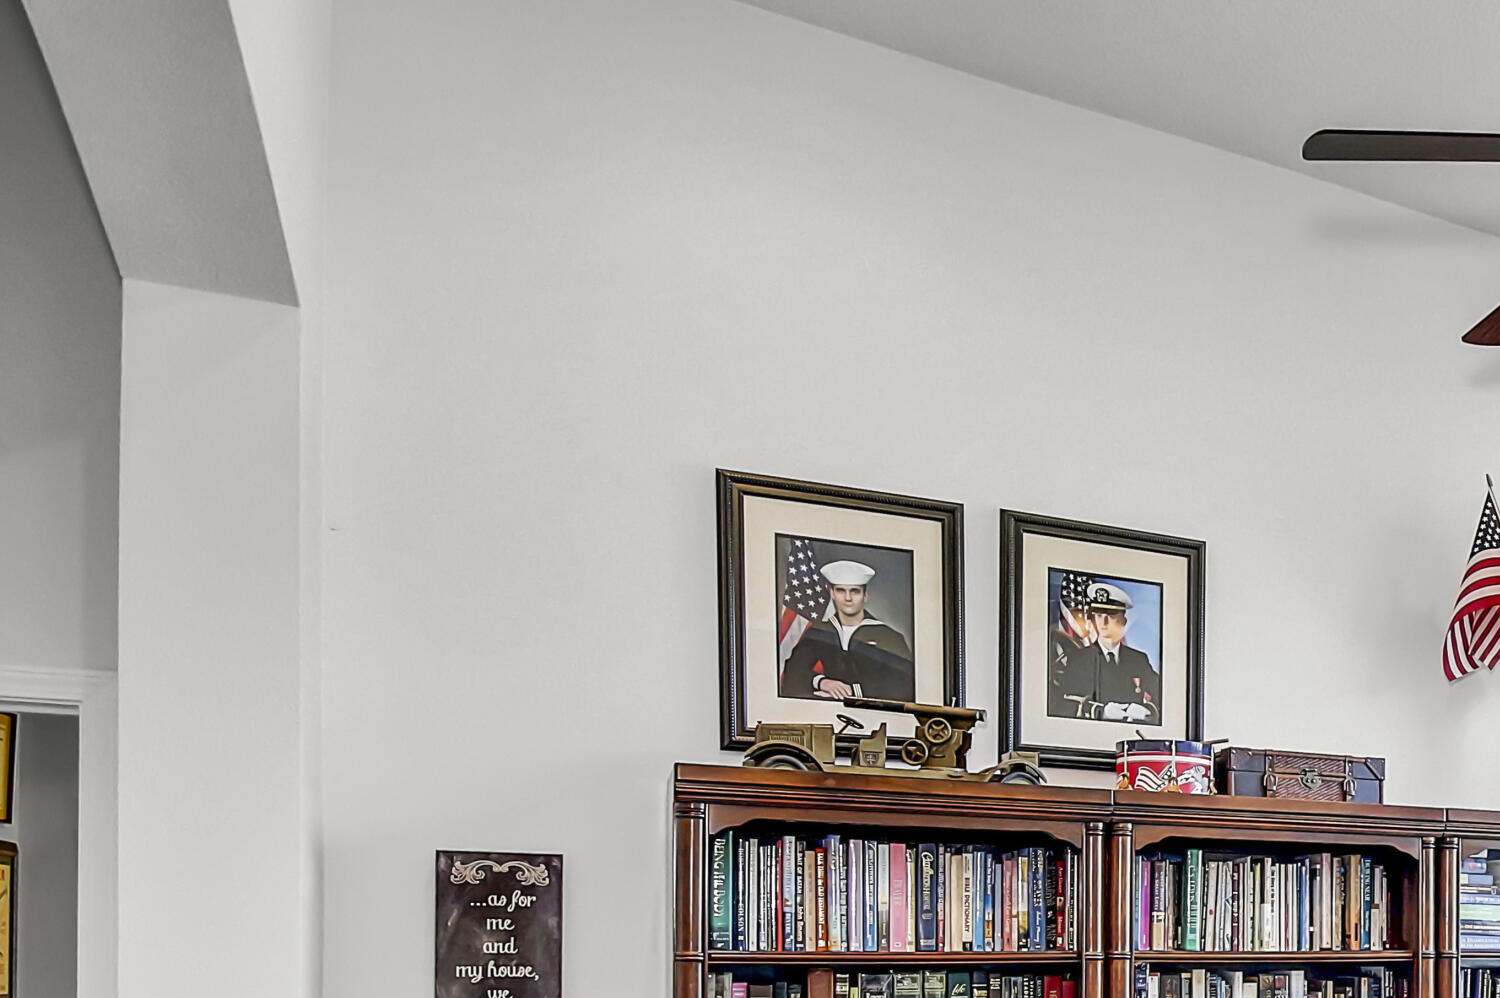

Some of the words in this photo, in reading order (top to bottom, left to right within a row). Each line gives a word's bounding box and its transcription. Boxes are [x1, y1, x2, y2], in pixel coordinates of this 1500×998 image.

[714, 839, 726, 868] BEING
[507, 889, 536, 912] for
[713, 889, 726, 917] BODY
[486, 917, 515, 931] me
[483, 938, 519, 954] and
[455, 964, 484, 983] my
[487, 960, 540, 981] house,
